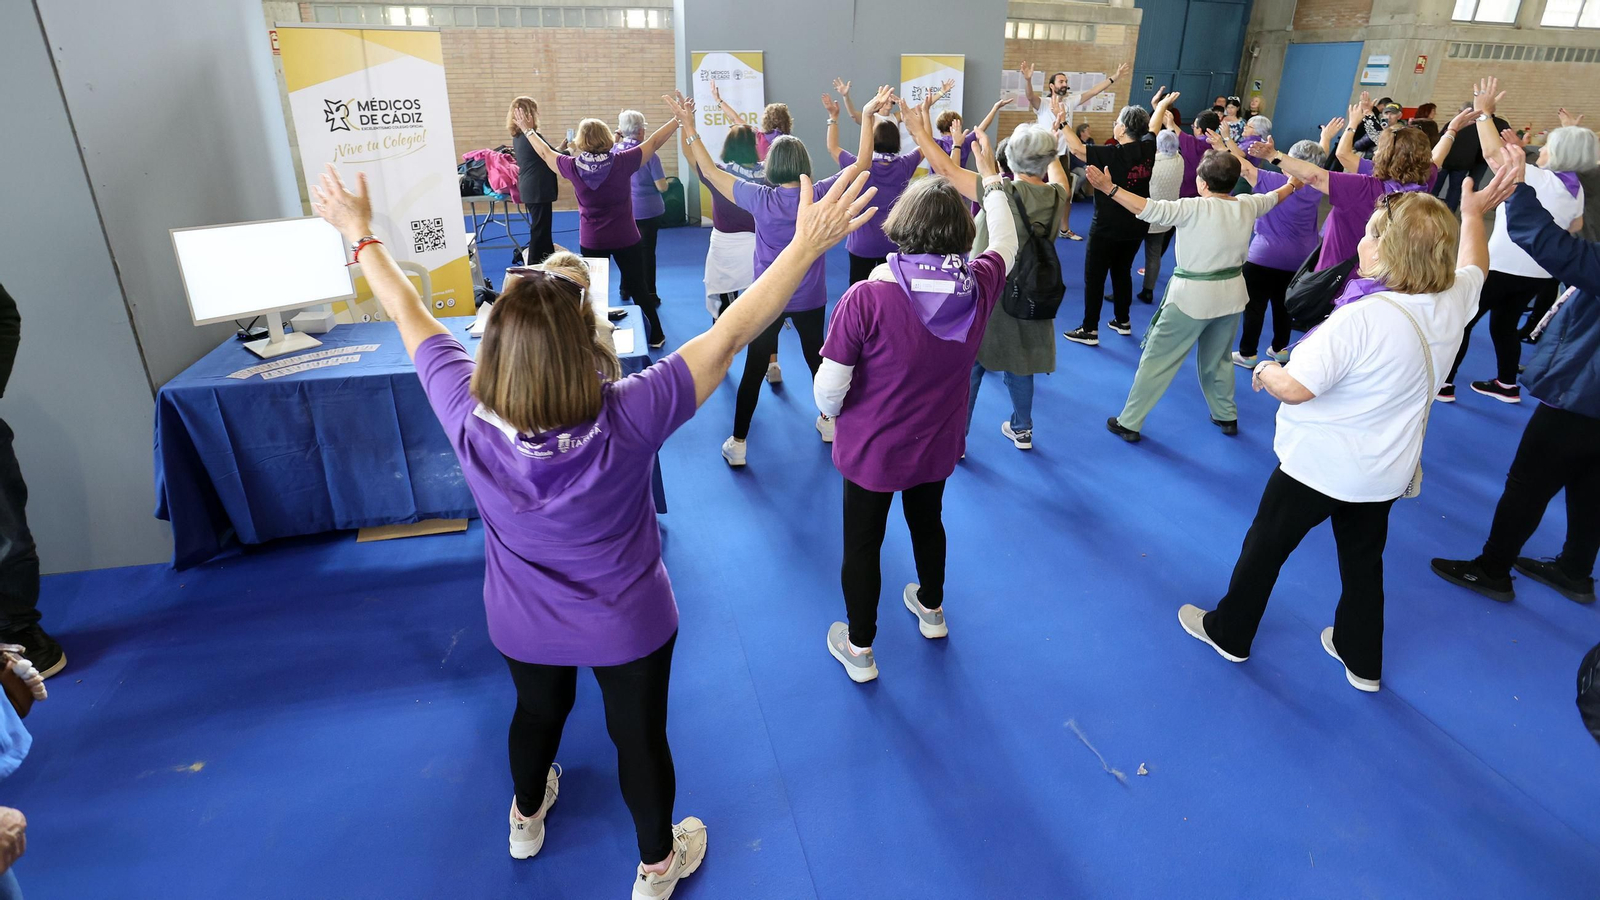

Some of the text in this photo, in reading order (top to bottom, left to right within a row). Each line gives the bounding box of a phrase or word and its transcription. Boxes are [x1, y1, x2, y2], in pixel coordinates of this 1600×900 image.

[357, 97, 421, 111] MÉDICOS
[360, 110, 423, 125] DE CÁDIZ
[704, 112, 758, 126] SENOR
[333, 129, 427, 162] ¡Vive tu Colegio!
